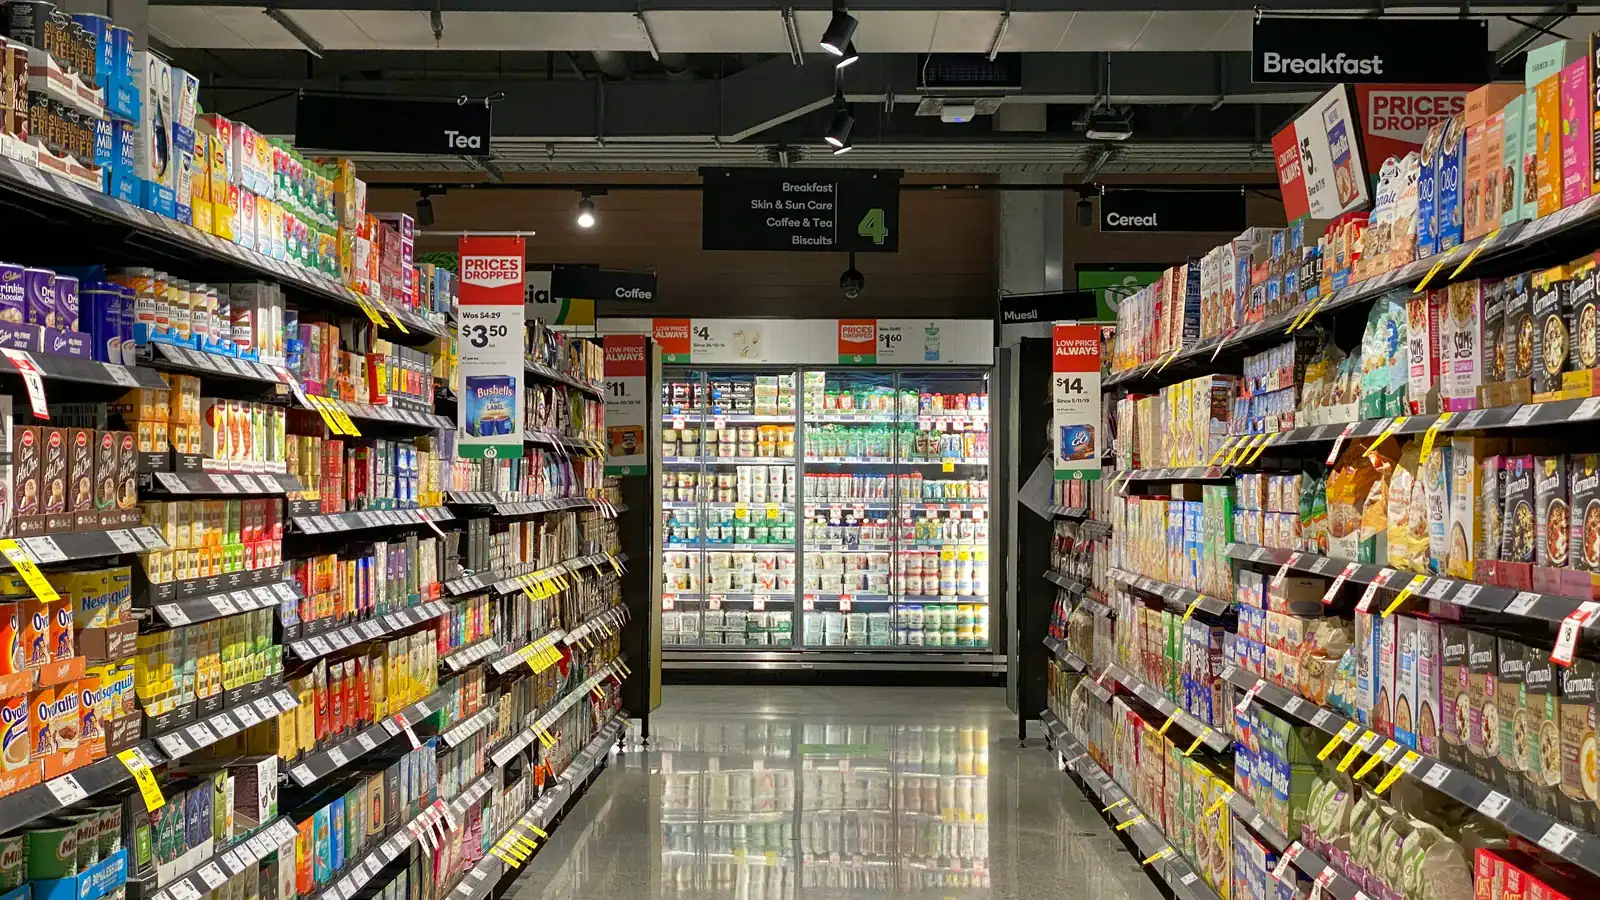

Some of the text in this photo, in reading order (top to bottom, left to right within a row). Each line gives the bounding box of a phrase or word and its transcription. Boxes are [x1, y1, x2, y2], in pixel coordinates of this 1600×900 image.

[1264, 52, 1383, 74] Breakfast
[1374, 96, 1464, 115] PRICES
[444, 131, 480, 149] Tea
[1280, 160, 1301, 186] ALWAYS
[782, 182, 833, 193] Breakfast
[751, 200, 833, 211] Skin & Sun Care
[766, 217, 833, 228] Coffee & Tea
[1107, 212, 1157, 226] Cereal
[858, 208, 888, 245] 4
[792, 235, 833, 246] Biscuits
[465, 259, 518, 270] PRICES
[464, 271, 519, 280] DROPPED
[615, 287, 652, 299] Coffee
[1004, 309, 1038, 321] Muesli
[655, 331, 689, 339] ALWAYS
[694, 326, 710, 341] $4
[1075, 339, 1097, 347] PRICE
[1056, 347, 1098, 355] ALWAYS
[477, 385, 513, 398] Bushells
[606, 381, 625, 397] $11
[1056, 378, 1083, 394] $14
[1525, 661, 1551, 684] Carman's
